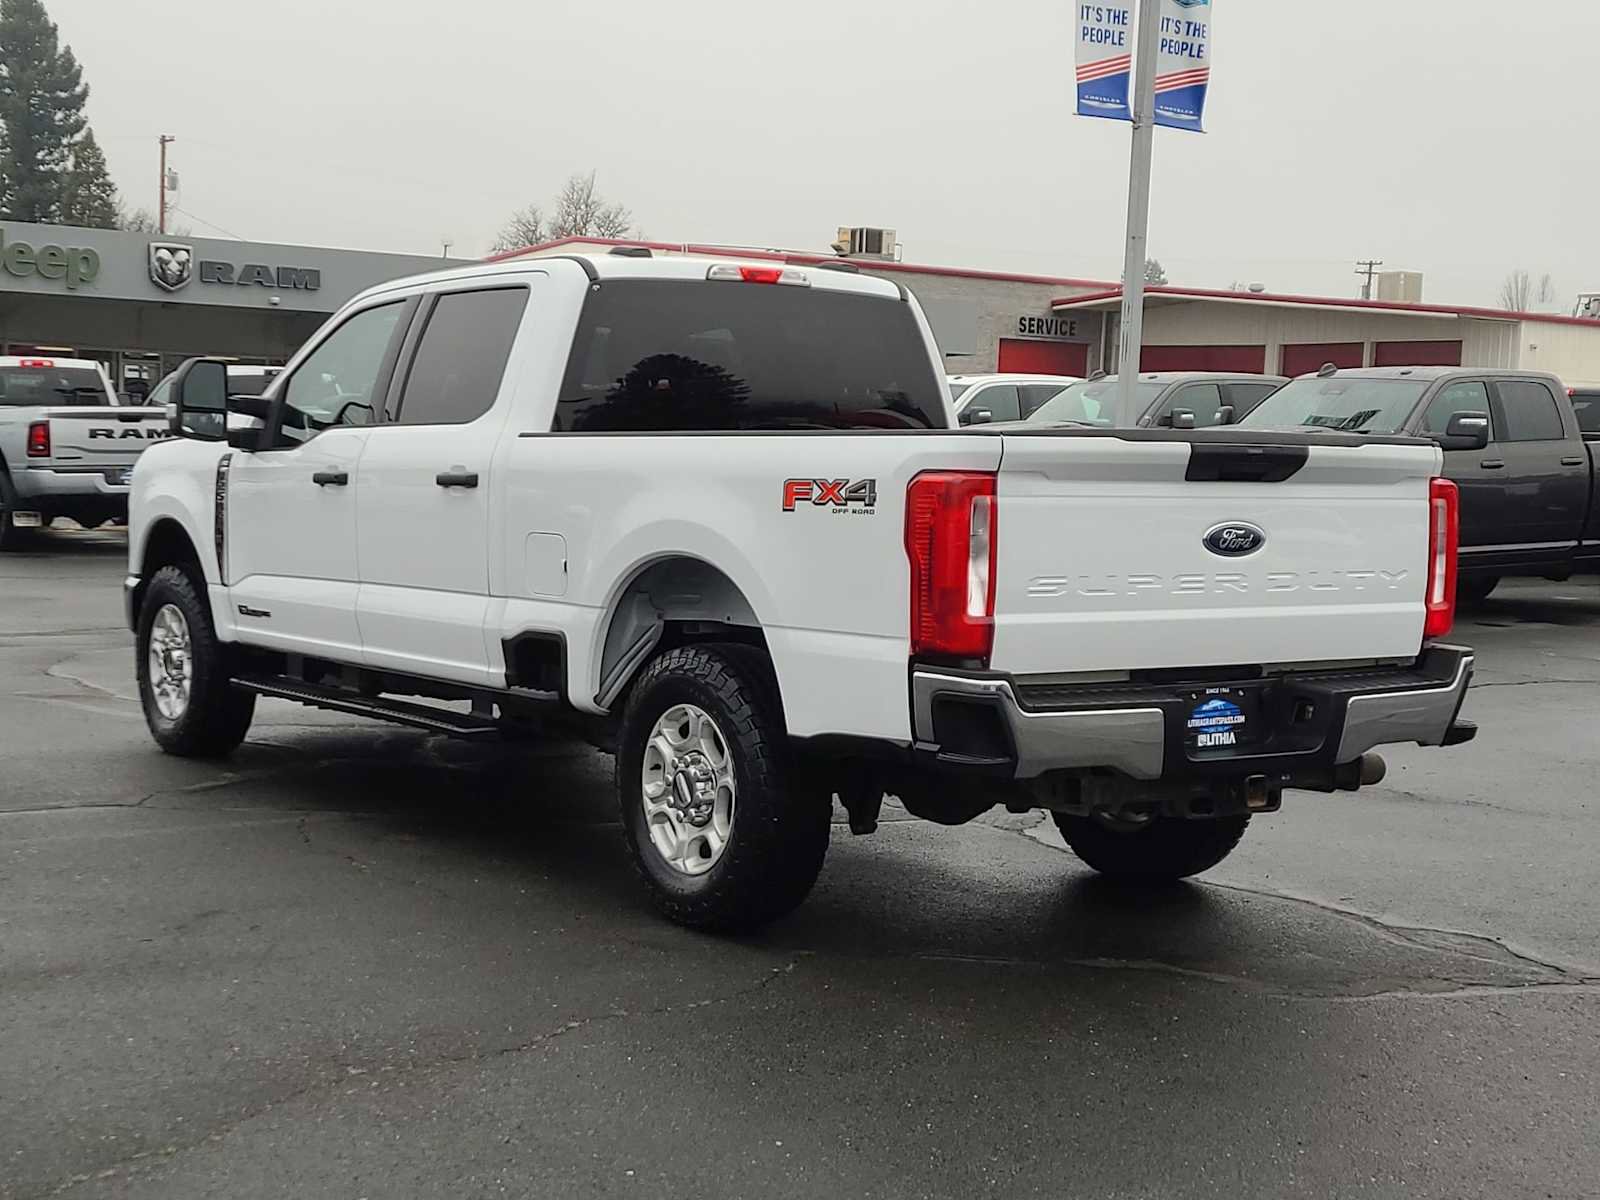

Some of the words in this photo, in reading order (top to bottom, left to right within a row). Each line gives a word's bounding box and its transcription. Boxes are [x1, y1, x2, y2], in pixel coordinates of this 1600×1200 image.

[1081, 4, 1103, 22] IT'S
[1106, 8, 1129, 26] THE
[1082, 26, 1125, 46] PEOPLE
[1161, 16, 1182, 35] IT'S
[1185, 21, 1207, 39] THE
[1160, 38, 1205, 59] PEOPLE
[0, 228, 100, 290] eep
[200, 260, 321, 290] RAM
[1018, 316, 1077, 337] SERVICE
[88, 428, 172, 439] RAM
[782, 479, 877, 512] FX4
[1219, 528, 1254, 549] Ford
[1026, 573, 1249, 597] SUPER
[1266, 569, 1409, 593] DUTY
